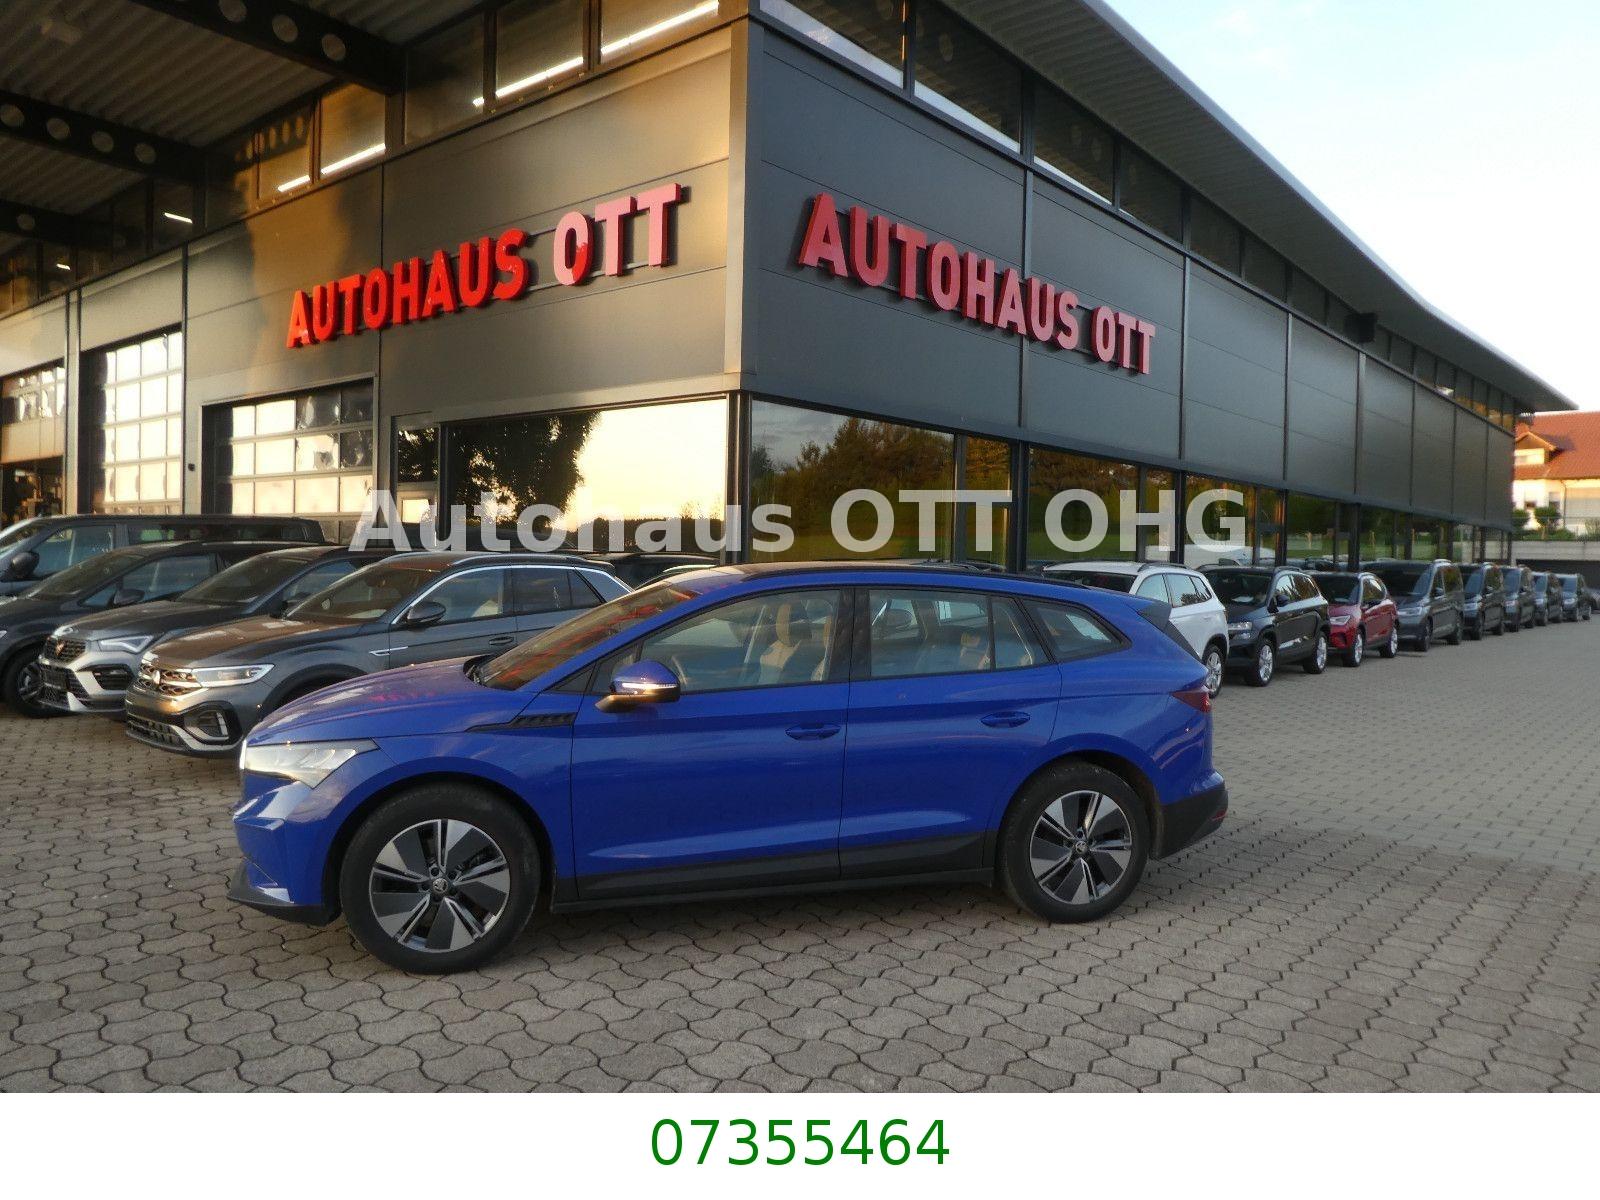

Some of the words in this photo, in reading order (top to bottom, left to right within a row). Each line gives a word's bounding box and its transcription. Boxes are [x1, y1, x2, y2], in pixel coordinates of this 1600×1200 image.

[286, 228, 531, 349] AUTOHAUS
[553, 182, 682, 286] OTT
[798, 192, 1079, 350] AUTOHAUS
[1091, 305, 1156, 375] OTT
